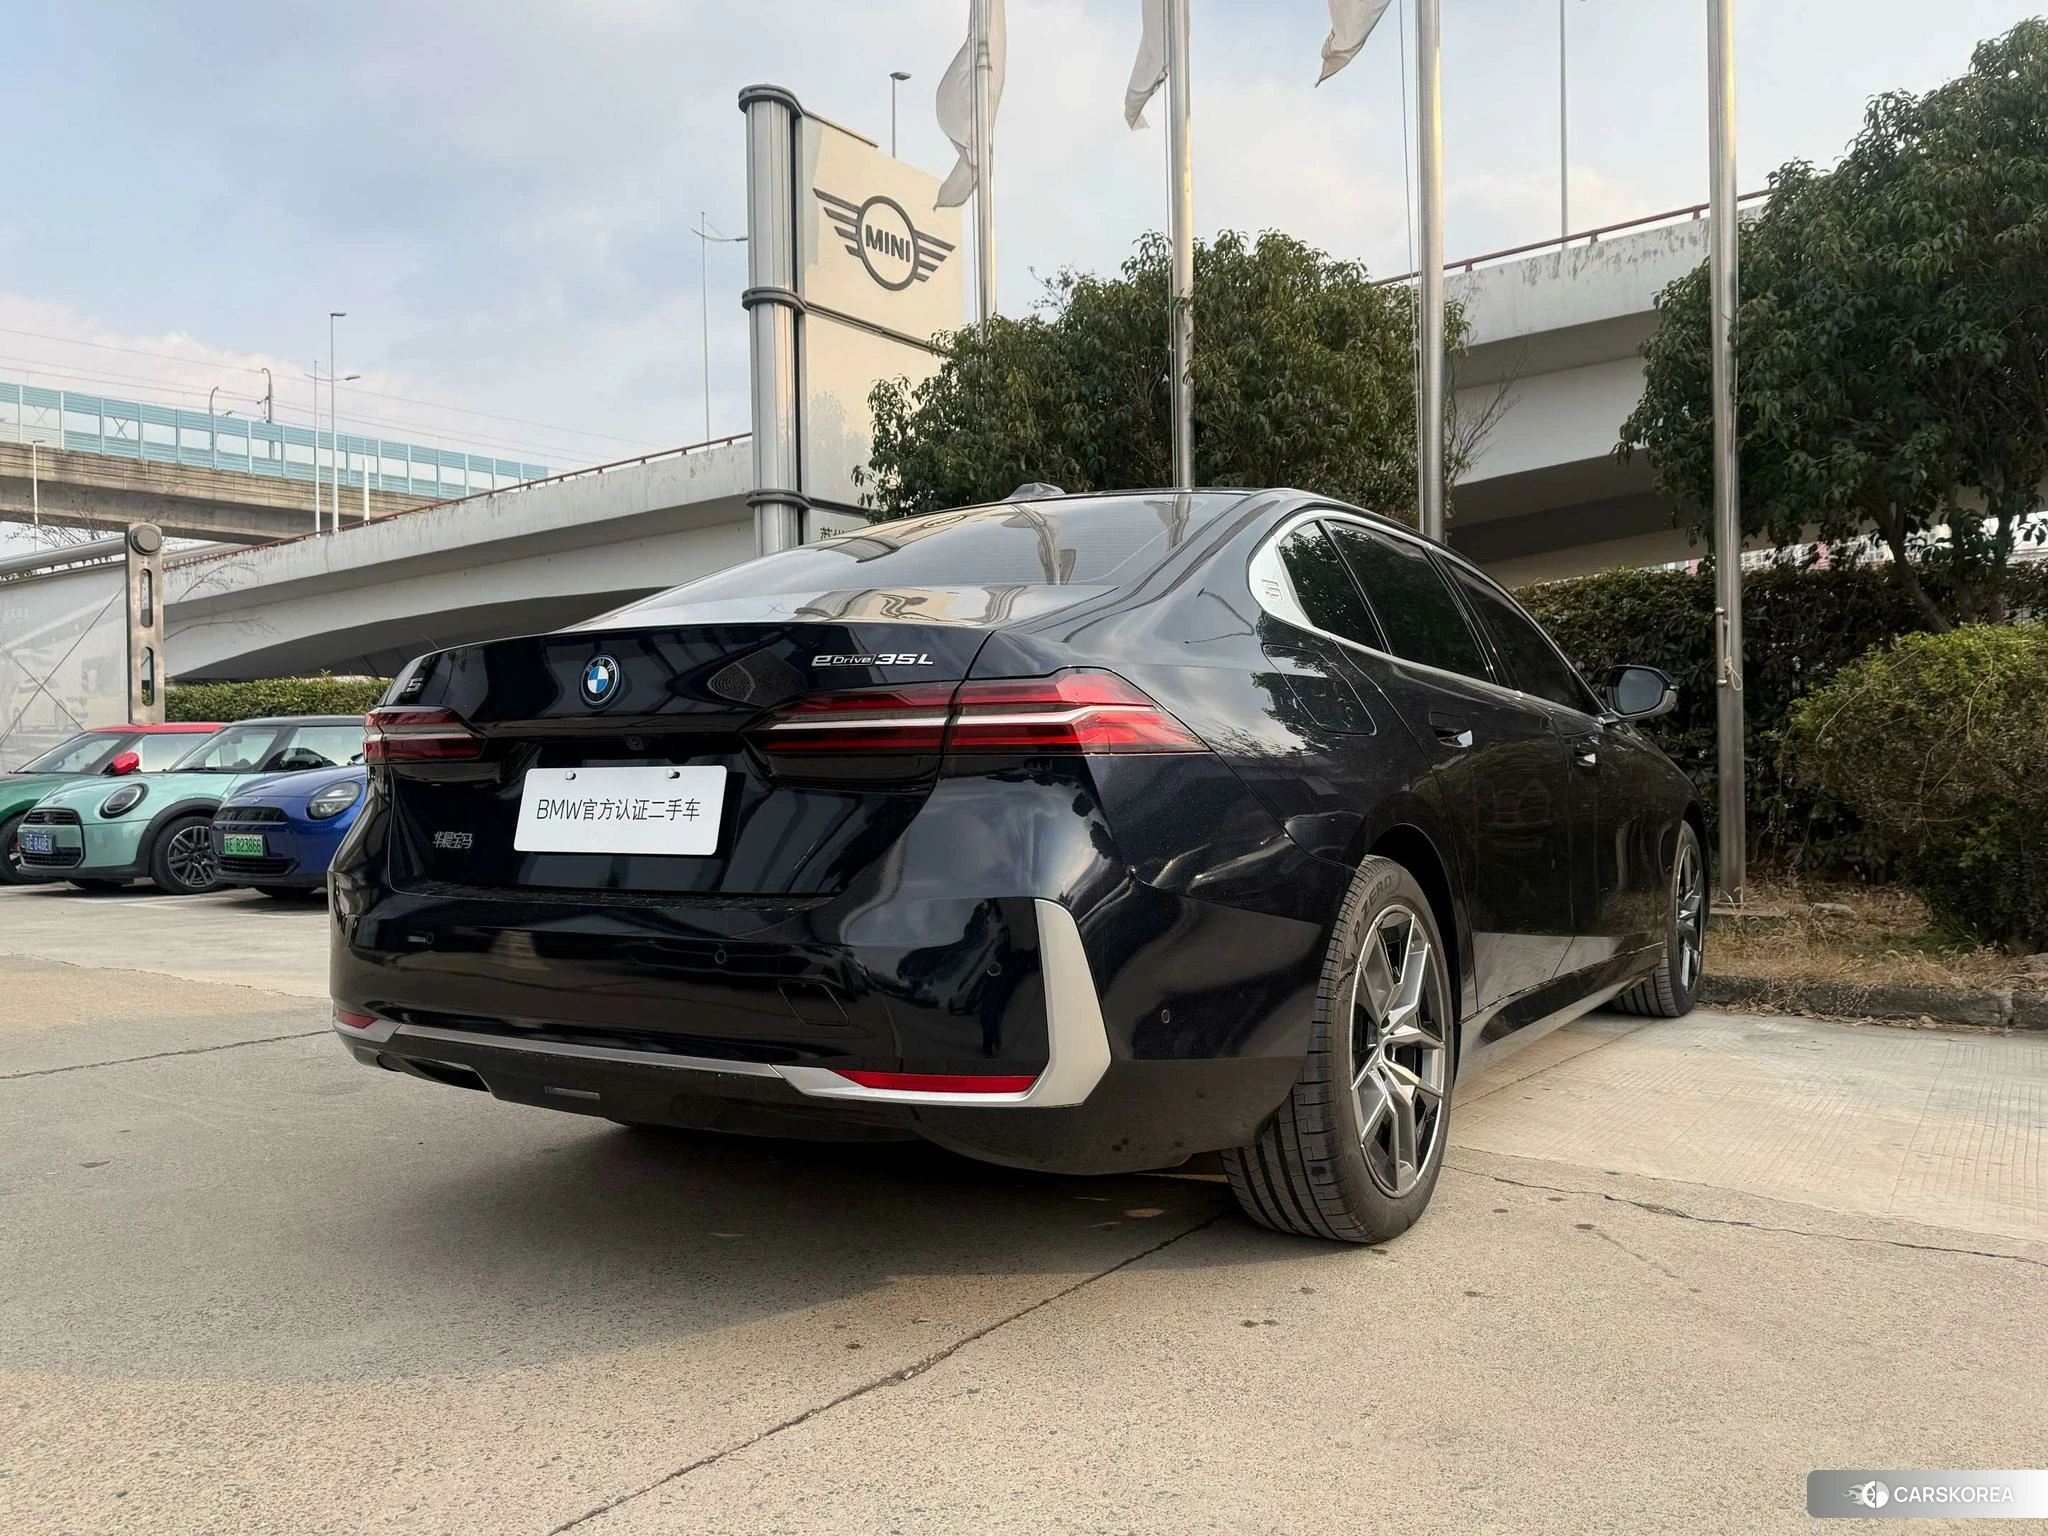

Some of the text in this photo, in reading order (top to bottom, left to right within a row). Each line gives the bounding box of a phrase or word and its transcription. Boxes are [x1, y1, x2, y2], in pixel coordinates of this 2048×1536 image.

[866, 224, 910, 262] MINI
[536, 798, 701, 822] BMW官方认证二手车
